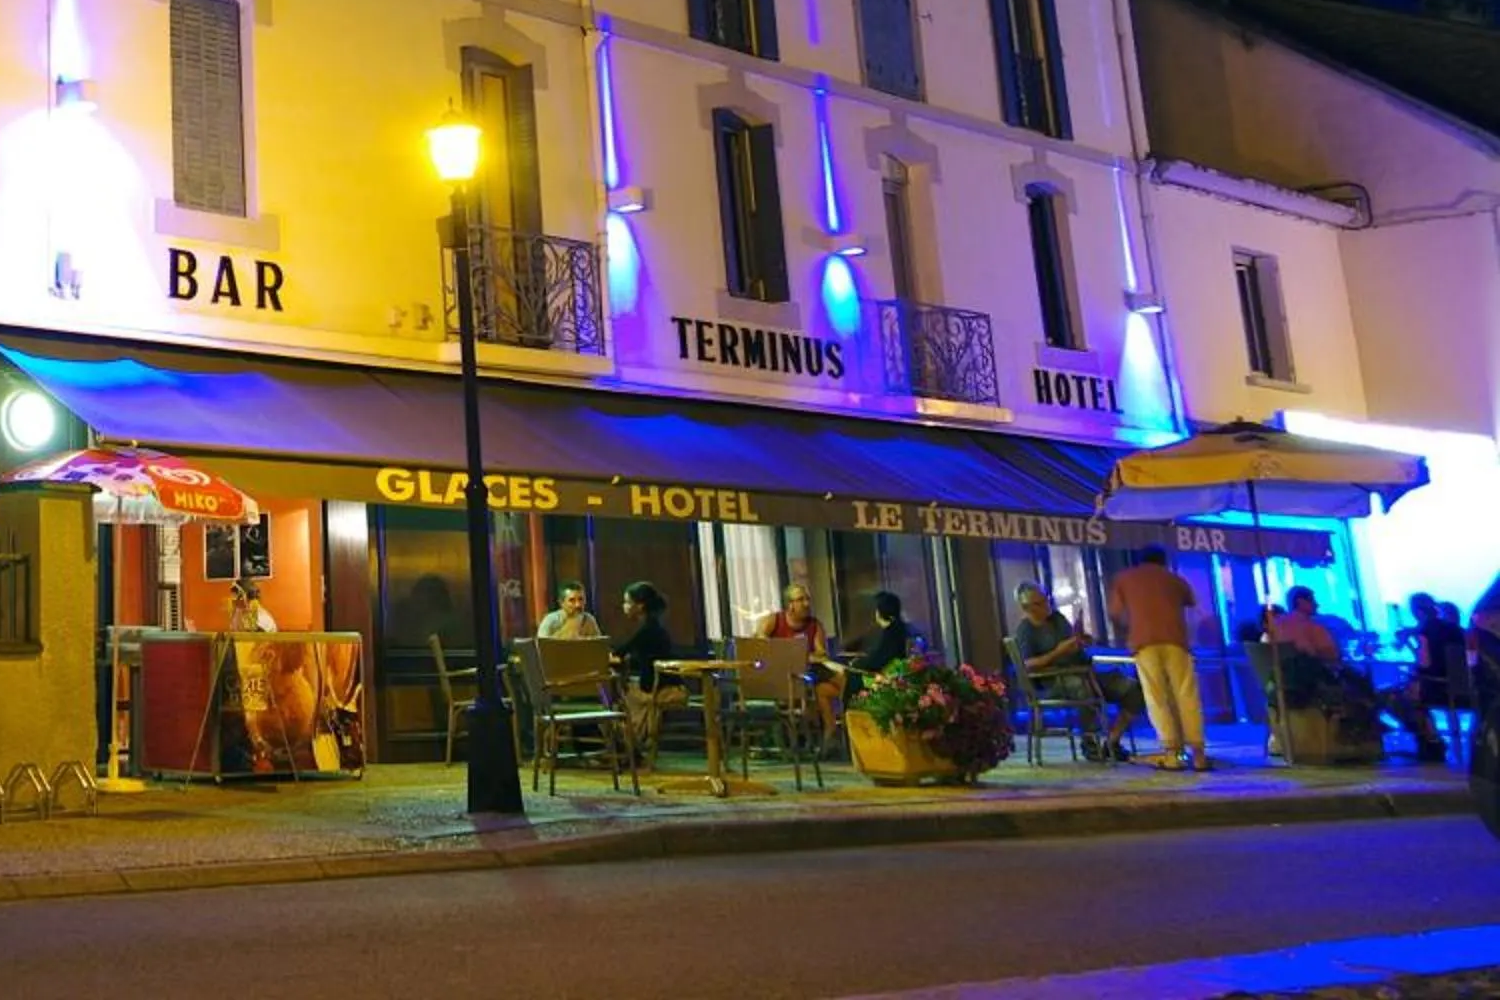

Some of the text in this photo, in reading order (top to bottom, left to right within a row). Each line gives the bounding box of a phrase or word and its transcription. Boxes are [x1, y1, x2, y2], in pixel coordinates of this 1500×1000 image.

[168, 247, 284, 313] BAR
[671, 316, 845, 379] TERMINUS
[1033, 368, 1123, 414] HOTEL
[375, 467, 559, 510] GLACES
[630, 484, 758, 521] HOTEL
[852, 499, 1108, 547] LE TERMINUS
[1176, 527, 1226, 553] BAR
